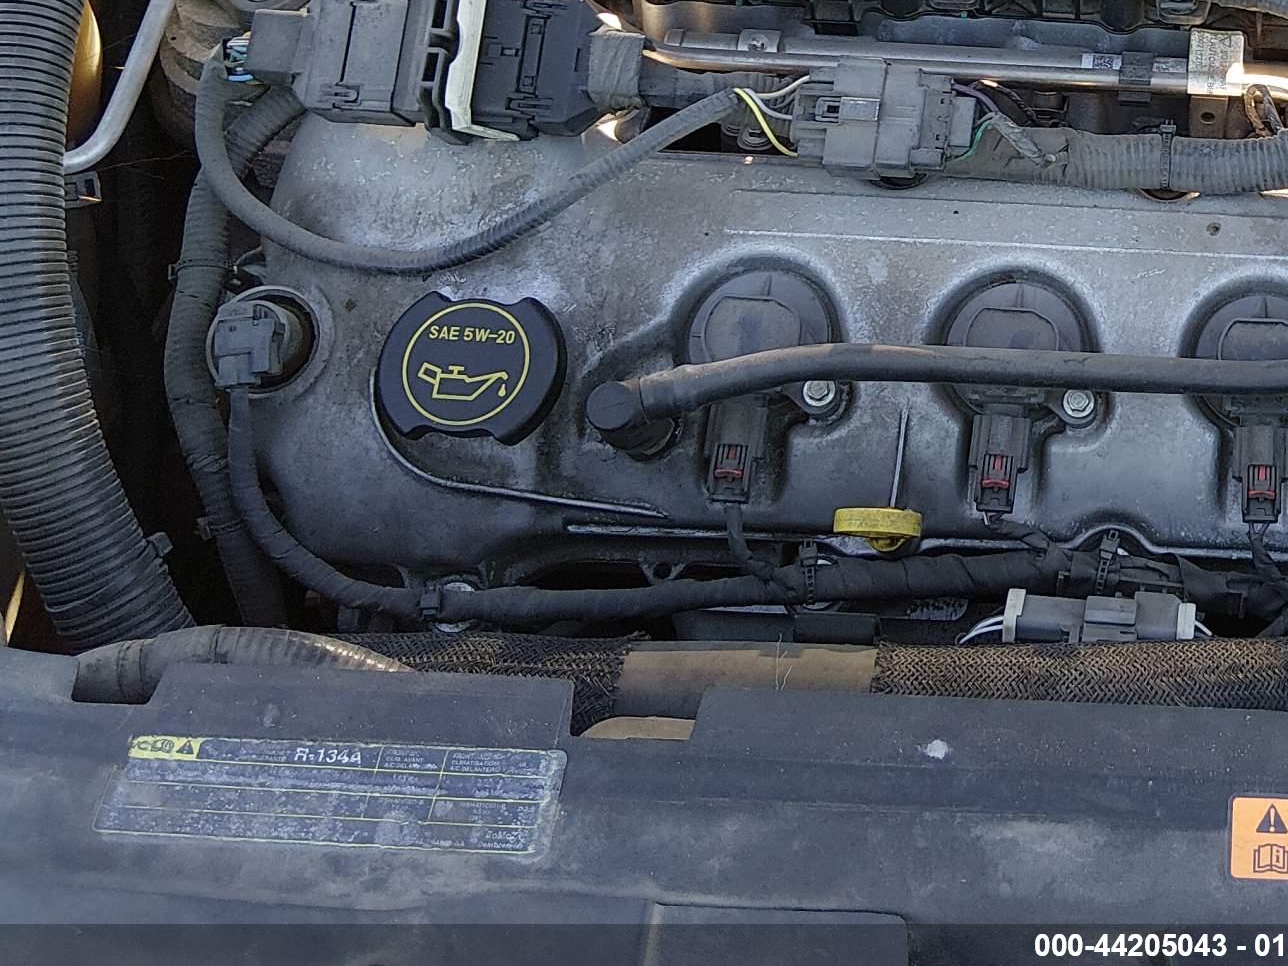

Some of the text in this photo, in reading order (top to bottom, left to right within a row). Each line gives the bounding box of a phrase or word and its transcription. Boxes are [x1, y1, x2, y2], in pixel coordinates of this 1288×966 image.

[429, 325, 516, 345] SAE 5W-20
[293, 747, 362, 765] R-134A
